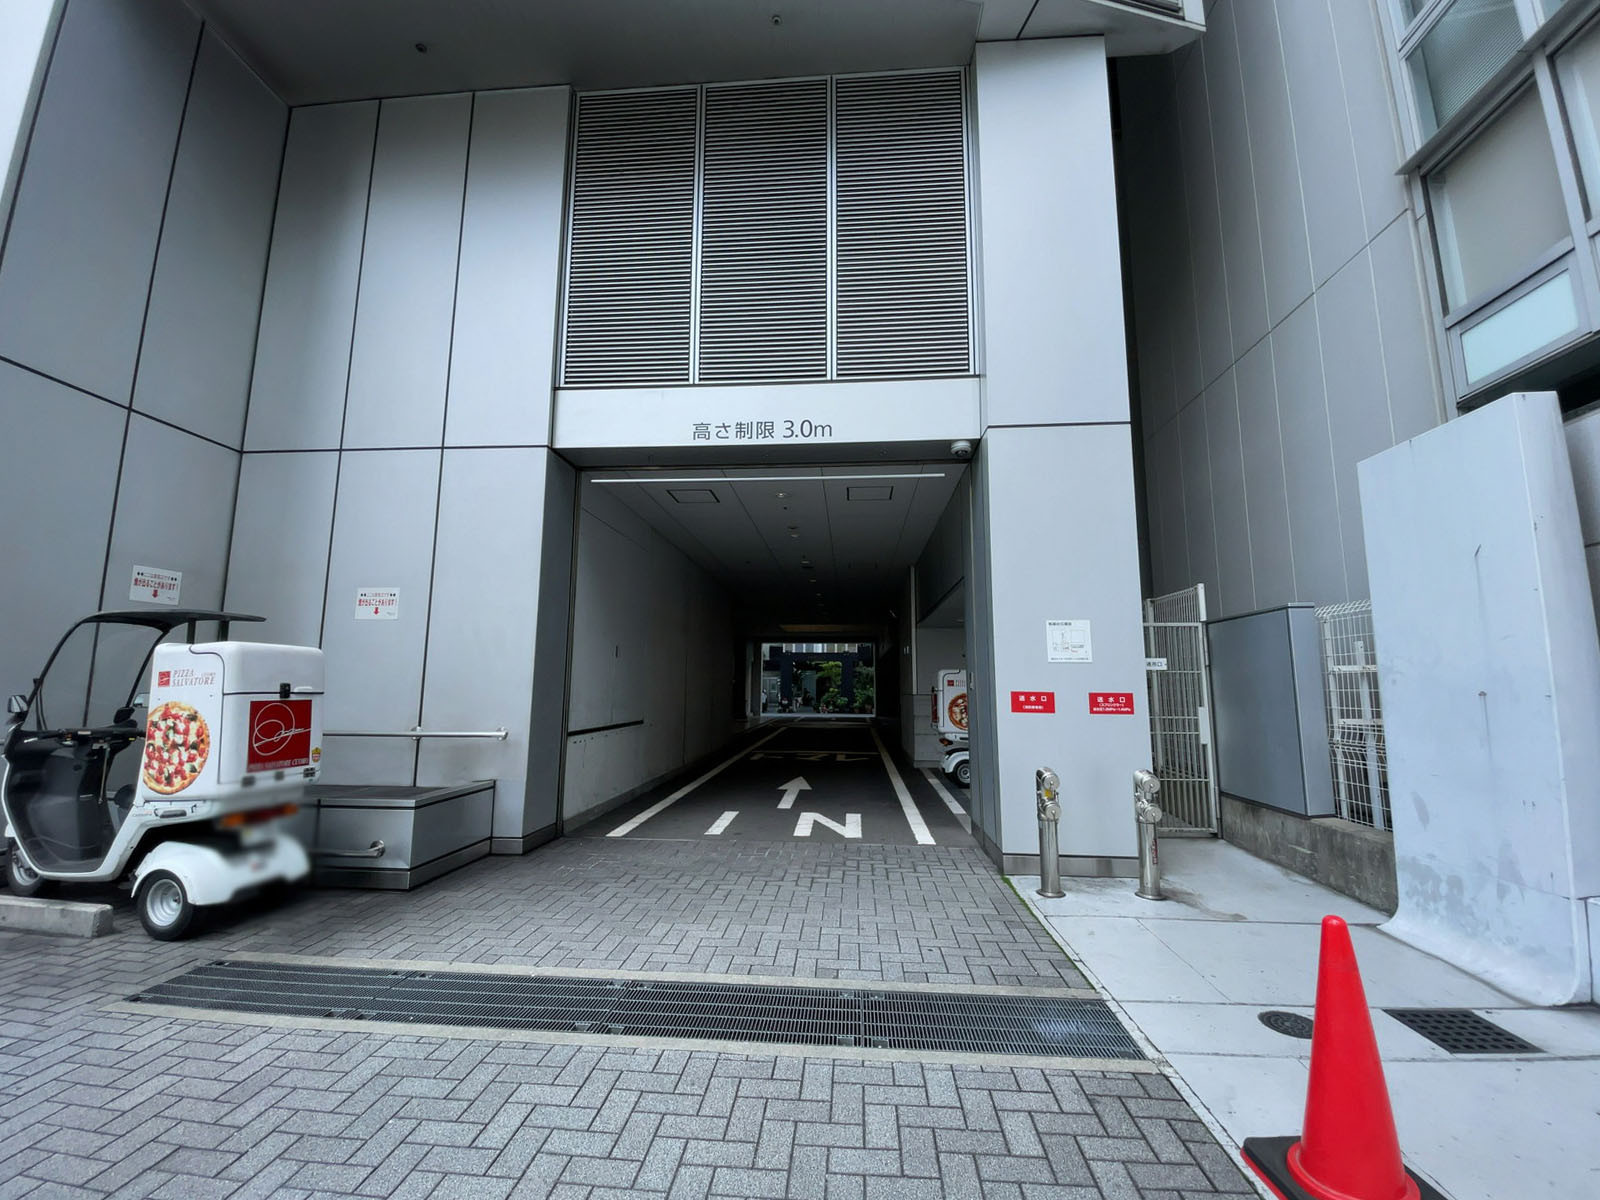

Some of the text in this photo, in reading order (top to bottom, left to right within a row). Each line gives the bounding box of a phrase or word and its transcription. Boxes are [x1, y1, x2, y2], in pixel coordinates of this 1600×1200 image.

[692, 419, 833, 441] 高さ制限 3.0m
[173, 669, 194, 678] PIZZA
[172, 677, 216, 687] SALVATORE
